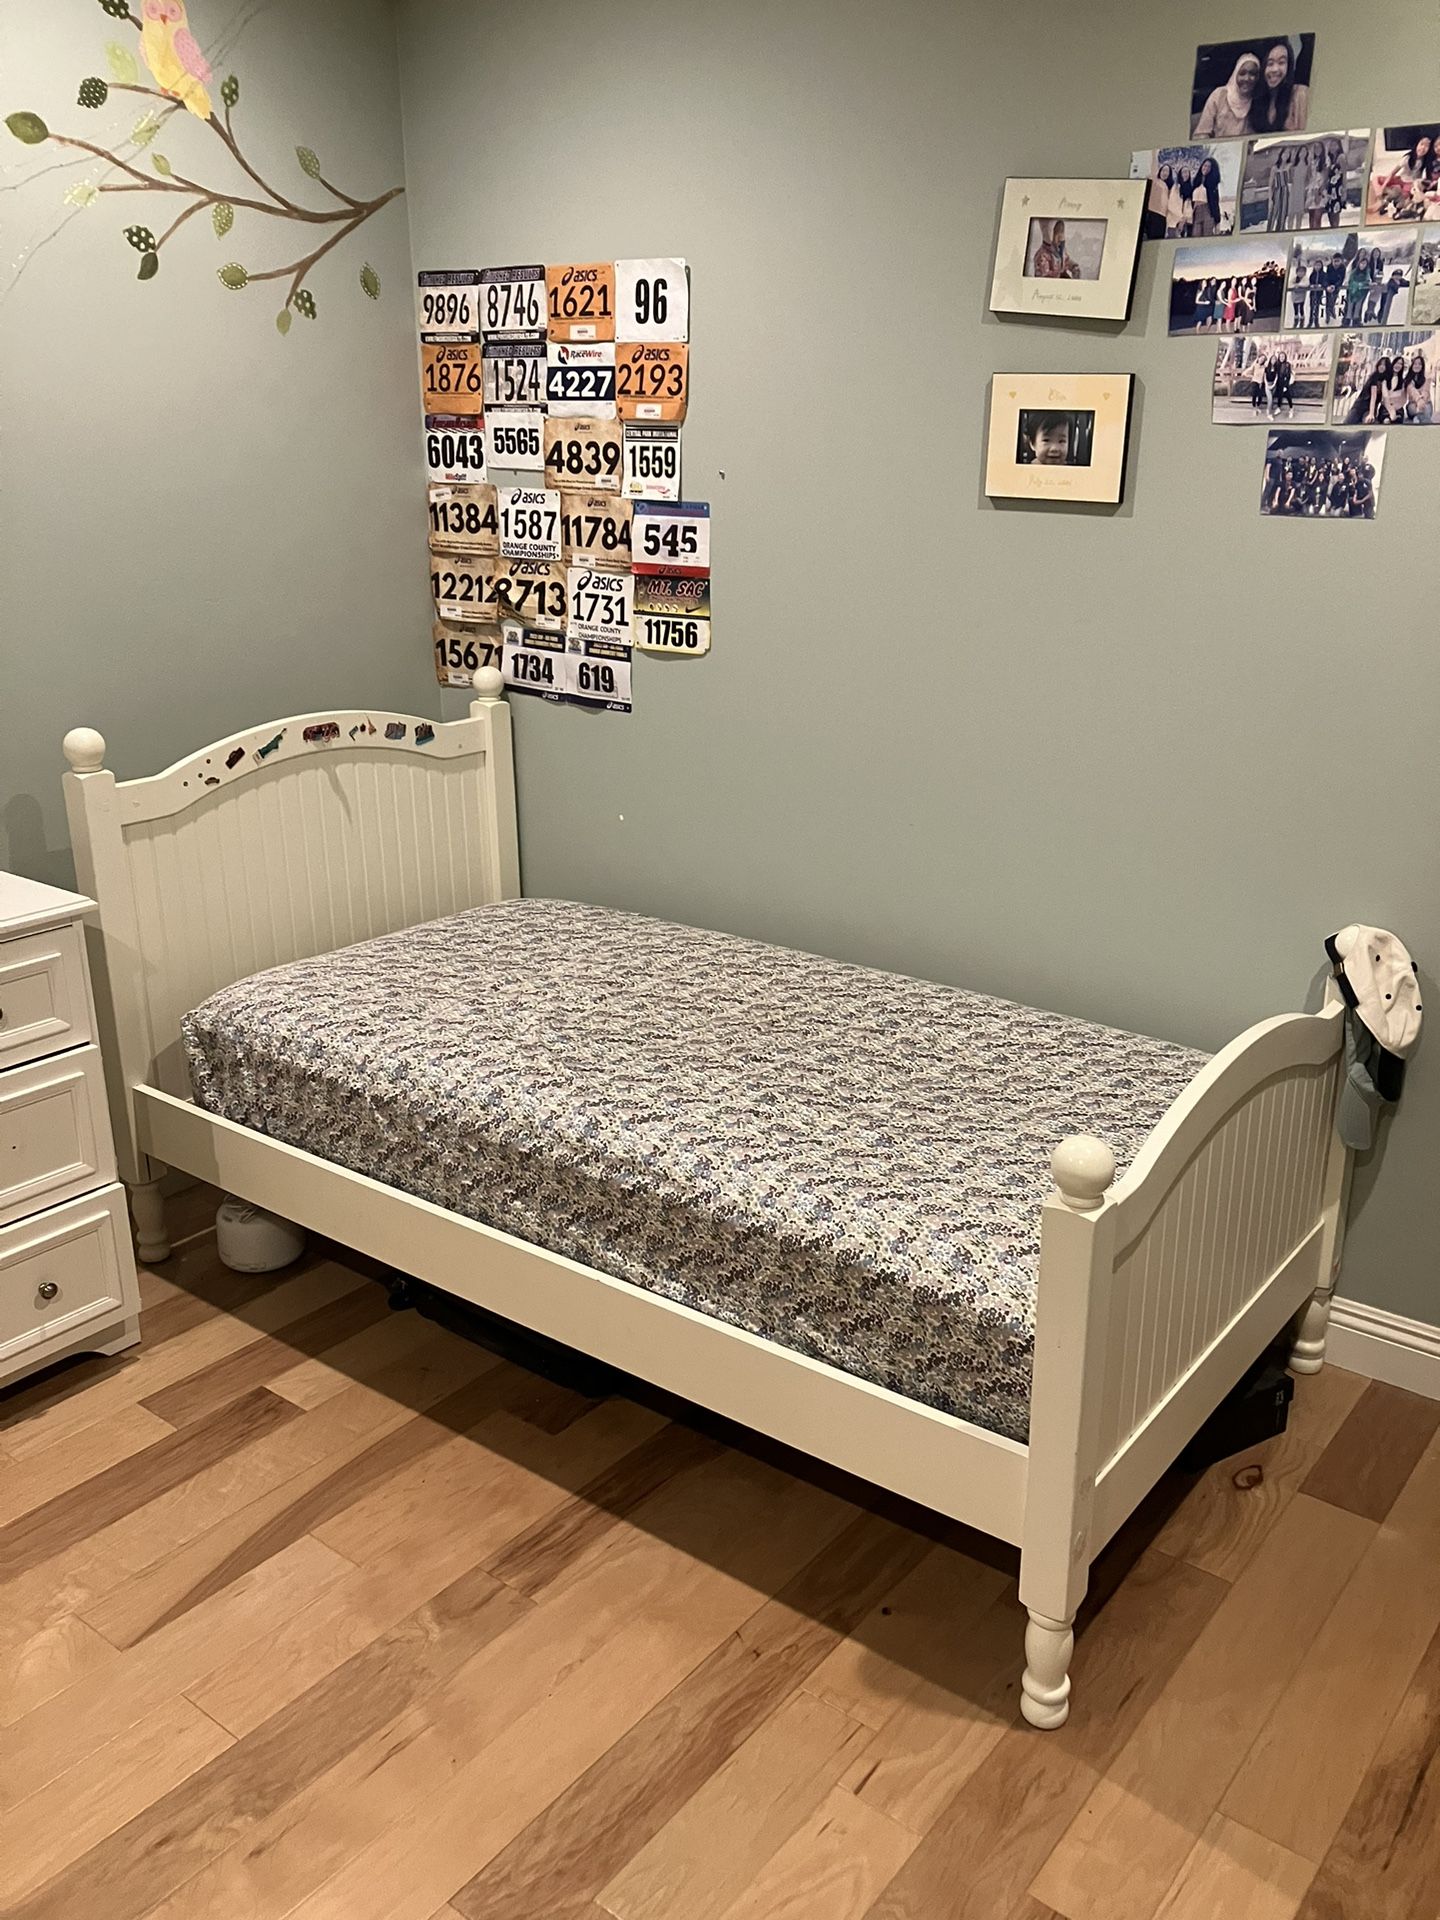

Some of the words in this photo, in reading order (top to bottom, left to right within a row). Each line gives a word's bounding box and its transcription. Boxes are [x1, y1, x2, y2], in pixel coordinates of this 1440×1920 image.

[423, 293, 470, 325] 9896
[487, 283, 539, 328] 8746
[549, 284, 612, 318] 1621
[635, 278, 668, 325] 96
[425, 363, 481, 392] 1876
[493, 359, 540, 401] 1524
[548, 370, 613, 398] 4227
[617, 363, 684, 396] 2193
[427, 434, 484, 470] 6043
[493, 427, 540, 456] 5565
[545, 440, 620, 475] 4839
[629, 445, 676, 479] 1559
[429, 502, 499, 535] 11384
[501, 508, 557, 541] 1587
[562, 514, 632, 552] 11784
[502, 541, 528, 551] ORANGE
[529, 543, 556, 552] COUNTY
[502, 549, 556, 559] CHAMPIONSHIPS
[643, 524, 698, 557] 545
[431, 572, 498, 603] 12212
[648, 579, 671, 595] MT.
[676, 581, 705, 598] SAC
[572, 591, 629, 627] 1731
[578, 623, 598, 632] ORANGE
[600, 626, 621, 634] COUNTY
[644, 618, 698, 648] 11756
[436, 638, 503, 672] 15671
[511, 653, 554, 684] 1734
[578, 662, 615, 693] 619
